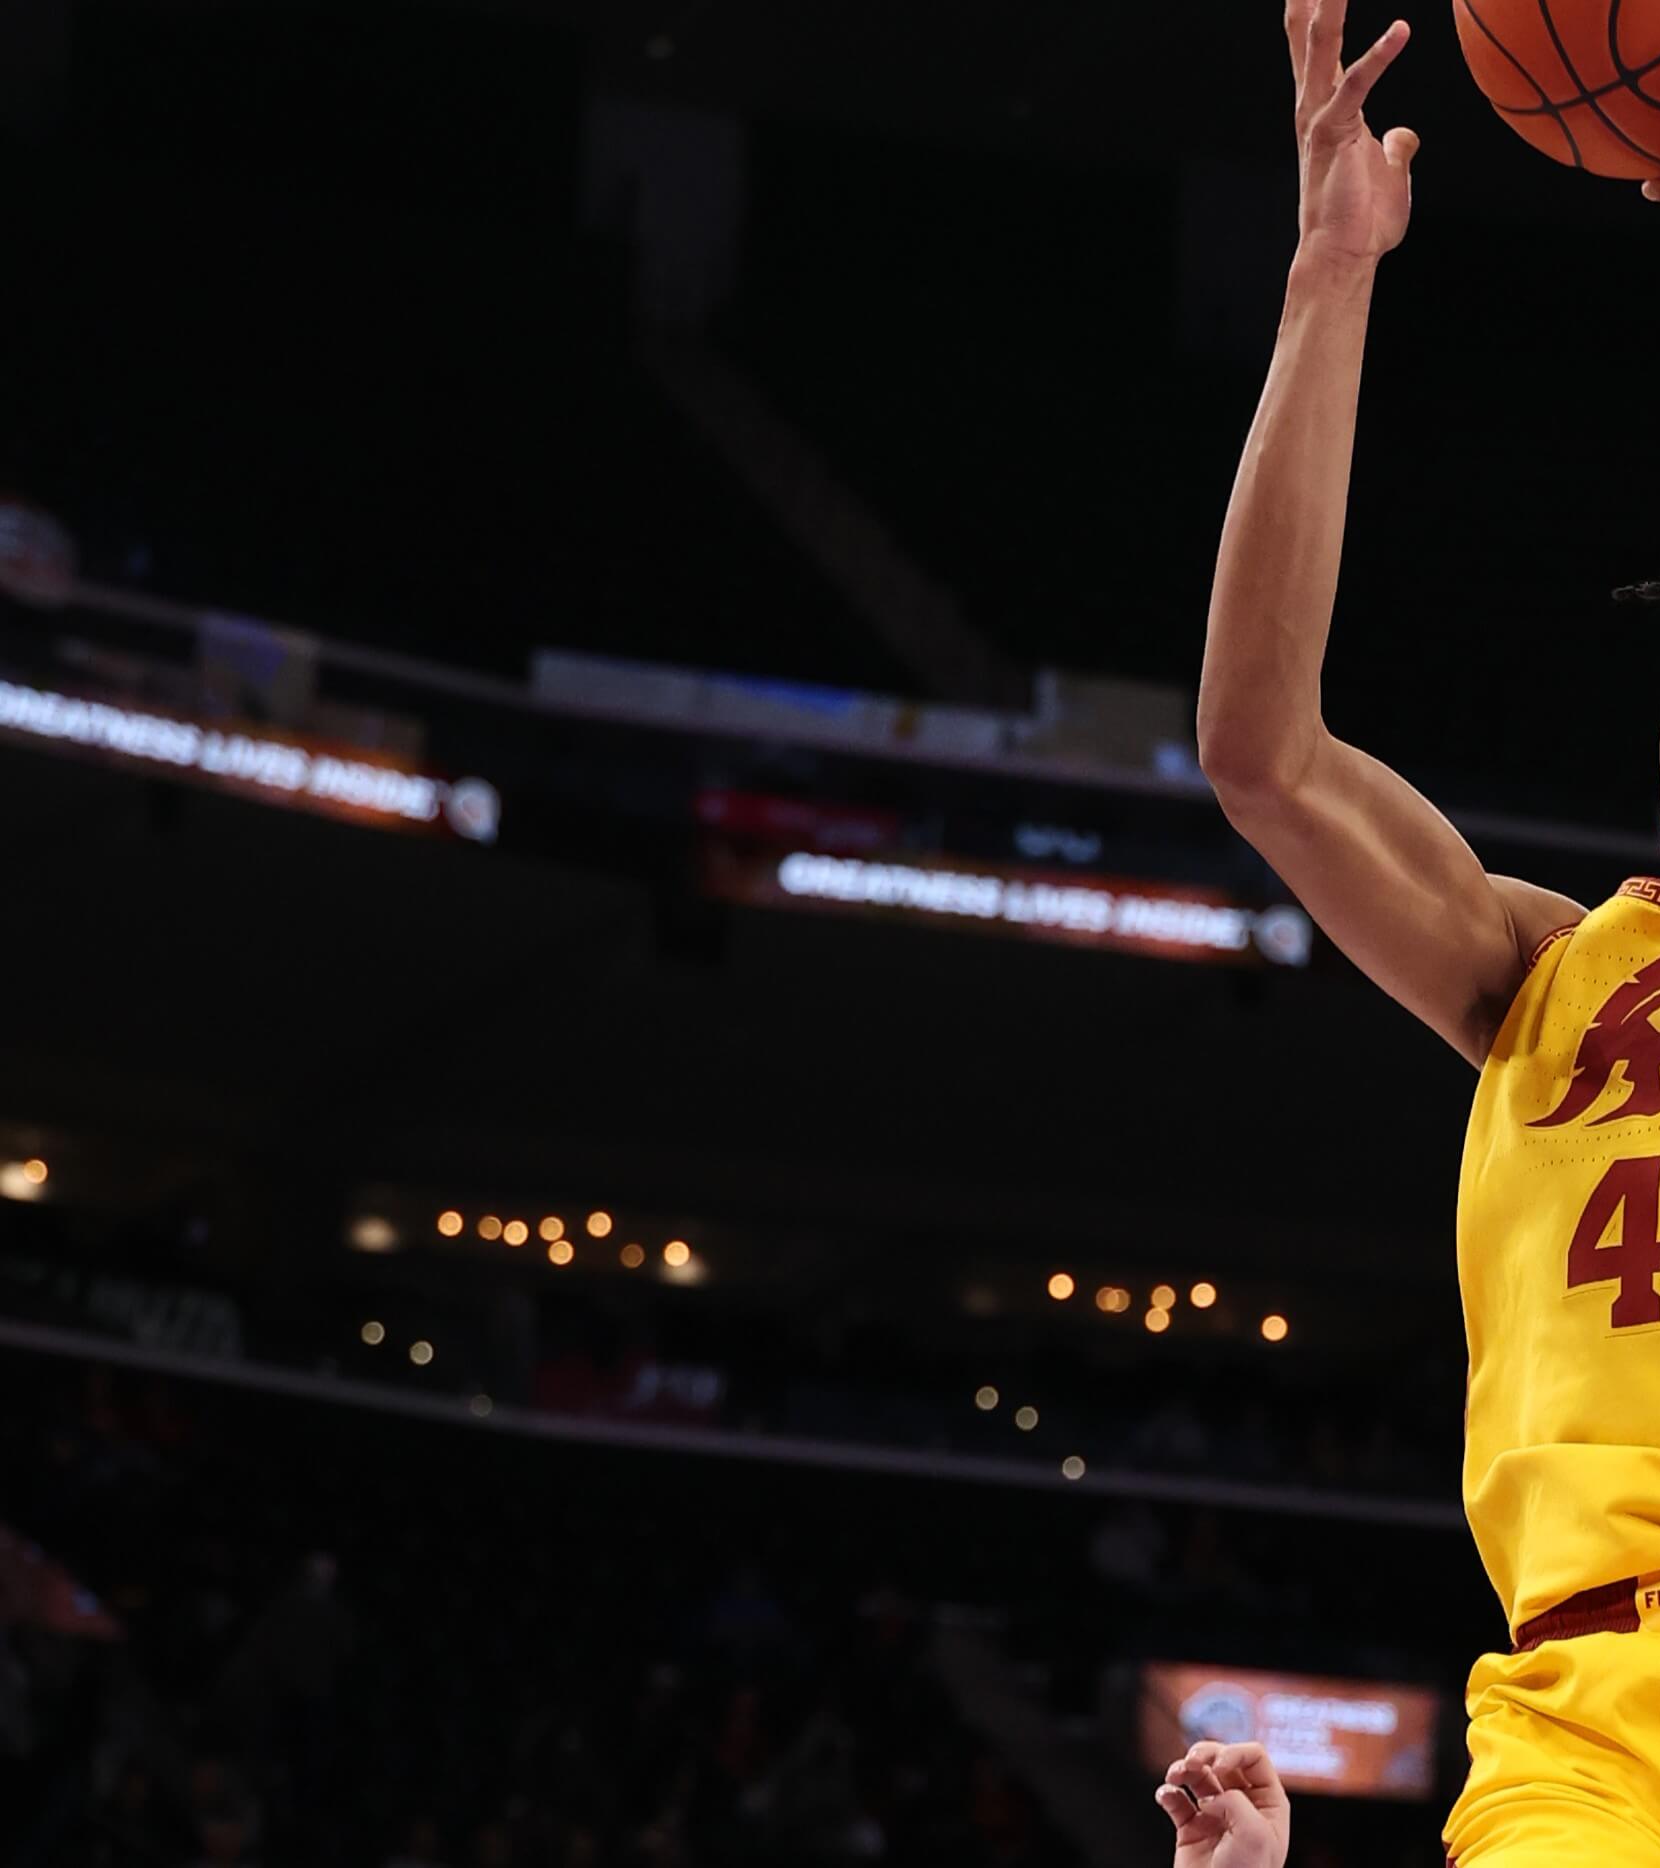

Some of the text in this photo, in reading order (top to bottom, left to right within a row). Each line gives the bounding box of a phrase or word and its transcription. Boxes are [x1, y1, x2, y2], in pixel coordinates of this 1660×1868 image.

[200, 731, 309, 790] LIVES
[308, 754, 438, 821] INSIDE
[778, 852, 1249, 951] GREATNESS LIVES INSIDE
